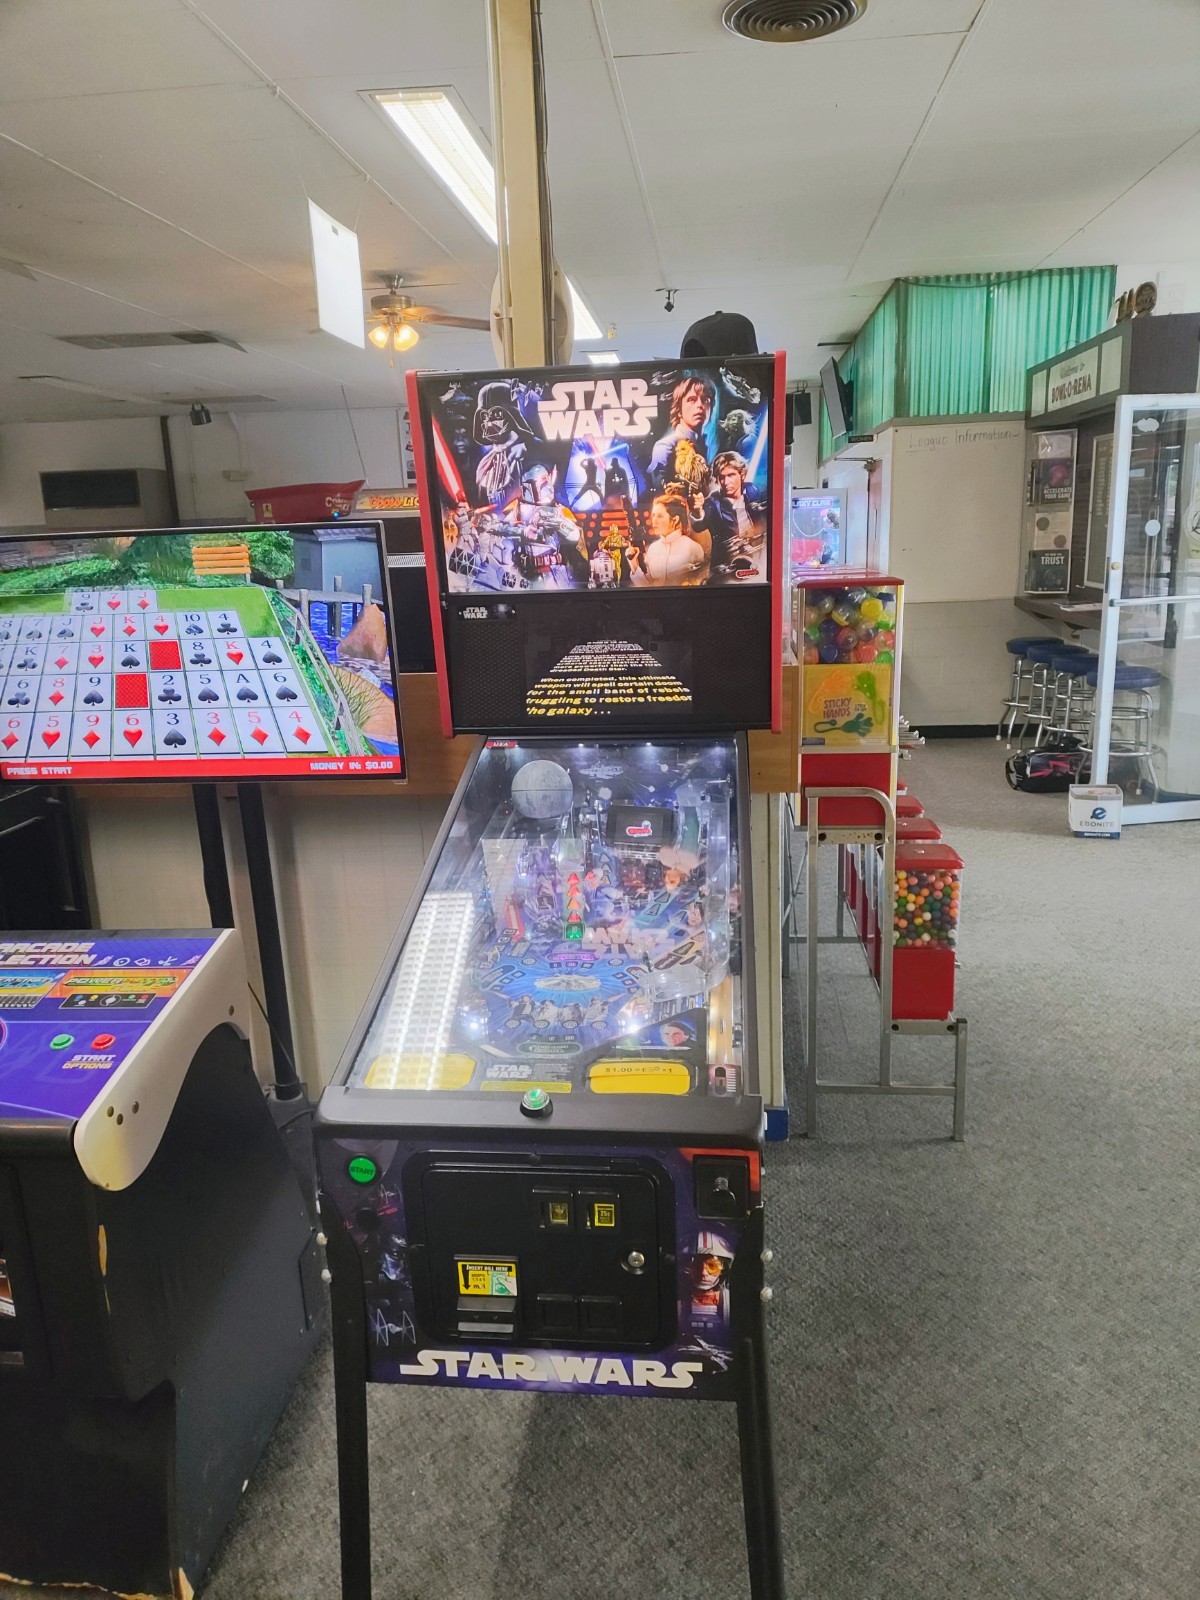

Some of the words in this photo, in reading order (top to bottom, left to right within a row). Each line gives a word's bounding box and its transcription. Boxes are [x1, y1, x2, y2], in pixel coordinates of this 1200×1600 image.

[538, 378, 658, 412] STAR
[538, 406, 658, 440] WARS
[909, 434, 948, 451] League
[956, 429, 1020, 444] Information
[1041, 556, 1065, 565] TRUST
[25, 646, 37, 655] K
[59, 646, 69, 654] 7
[91, 645, 102, 653] 3
[124, 644, 138, 652] K
[192, 642, 204, 650] 8
[226, 641, 239, 649] K
[261, 640, 272, 648] 4
[17, 679, 29, 689] 6
[53, 678, 64, 687] 8
[89, 677, 101, 686] 9
[162, 675, 174, 685] 2
[200, 674, 211, 684] 5
[236, 673, 250, 684] A
[273, 672, 286, 682] 6
[824, 697, 852, 709] STICKY
[8, 716, 20, 728] 6
[47, 716, 59, 727] 5
[87, 714, 99, 726] 9
[126, 714, 140, 726] 6
[166, 713, 179, 725] 3
[207, 712, 220, 724] 3
[248, 712, 261, 723] 5
[289, 711, 303, 722] 4
[823, 707, 850, 719] HANDS
[41, 766, 72, 774] START
[310, 762, 344, 770] MONEY
[365, 761, 393, 770] $0.00
[486, 1070, 532, 1079] WARS
[351, 1166, 374, 1175] START
[400, 1350, 548, 1382] STAR
[550, 1355, 703, 1388] WARS
